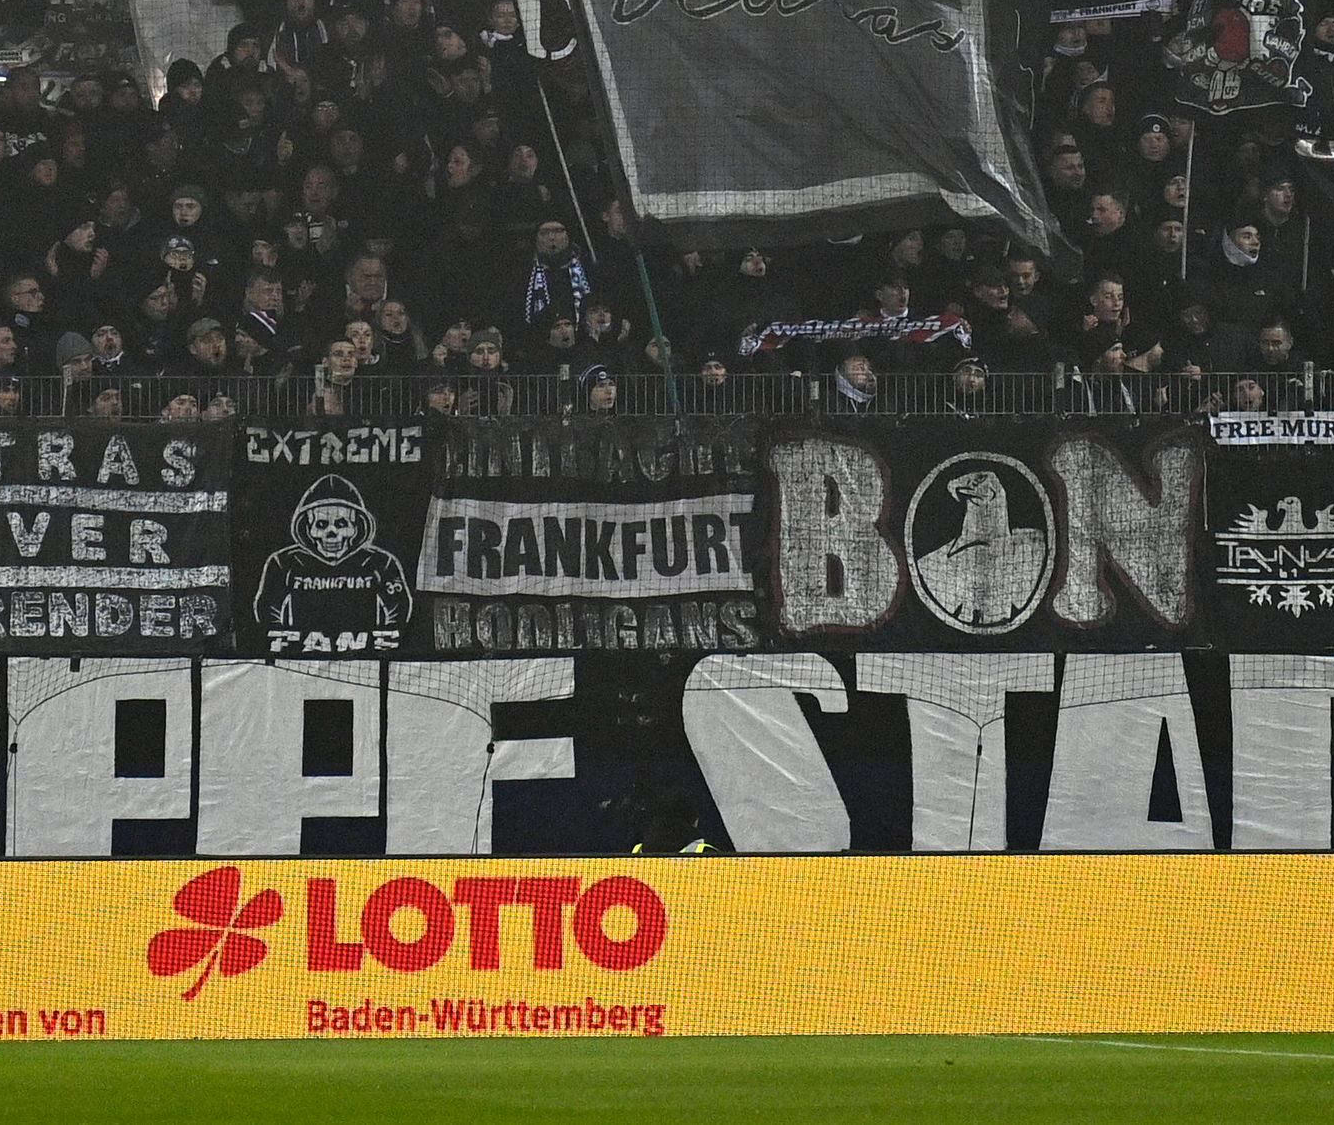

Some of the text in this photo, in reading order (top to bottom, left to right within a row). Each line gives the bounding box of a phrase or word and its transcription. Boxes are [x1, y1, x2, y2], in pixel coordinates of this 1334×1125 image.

[246, 427, 422, 466] EXTREME
[1215, 422, 1274, 439] FREE
[436, 512, 759, 581] FRANKFURT
[294, 578, 373, 590] FRANKFURT
[433, 599, 759, 651] HOOLIGANS
[310, 879, 665, 972] LOTTO
[41, 1013, 106, 1037] von
[308, 1002, 665, 1037] Baden-Württemberg
